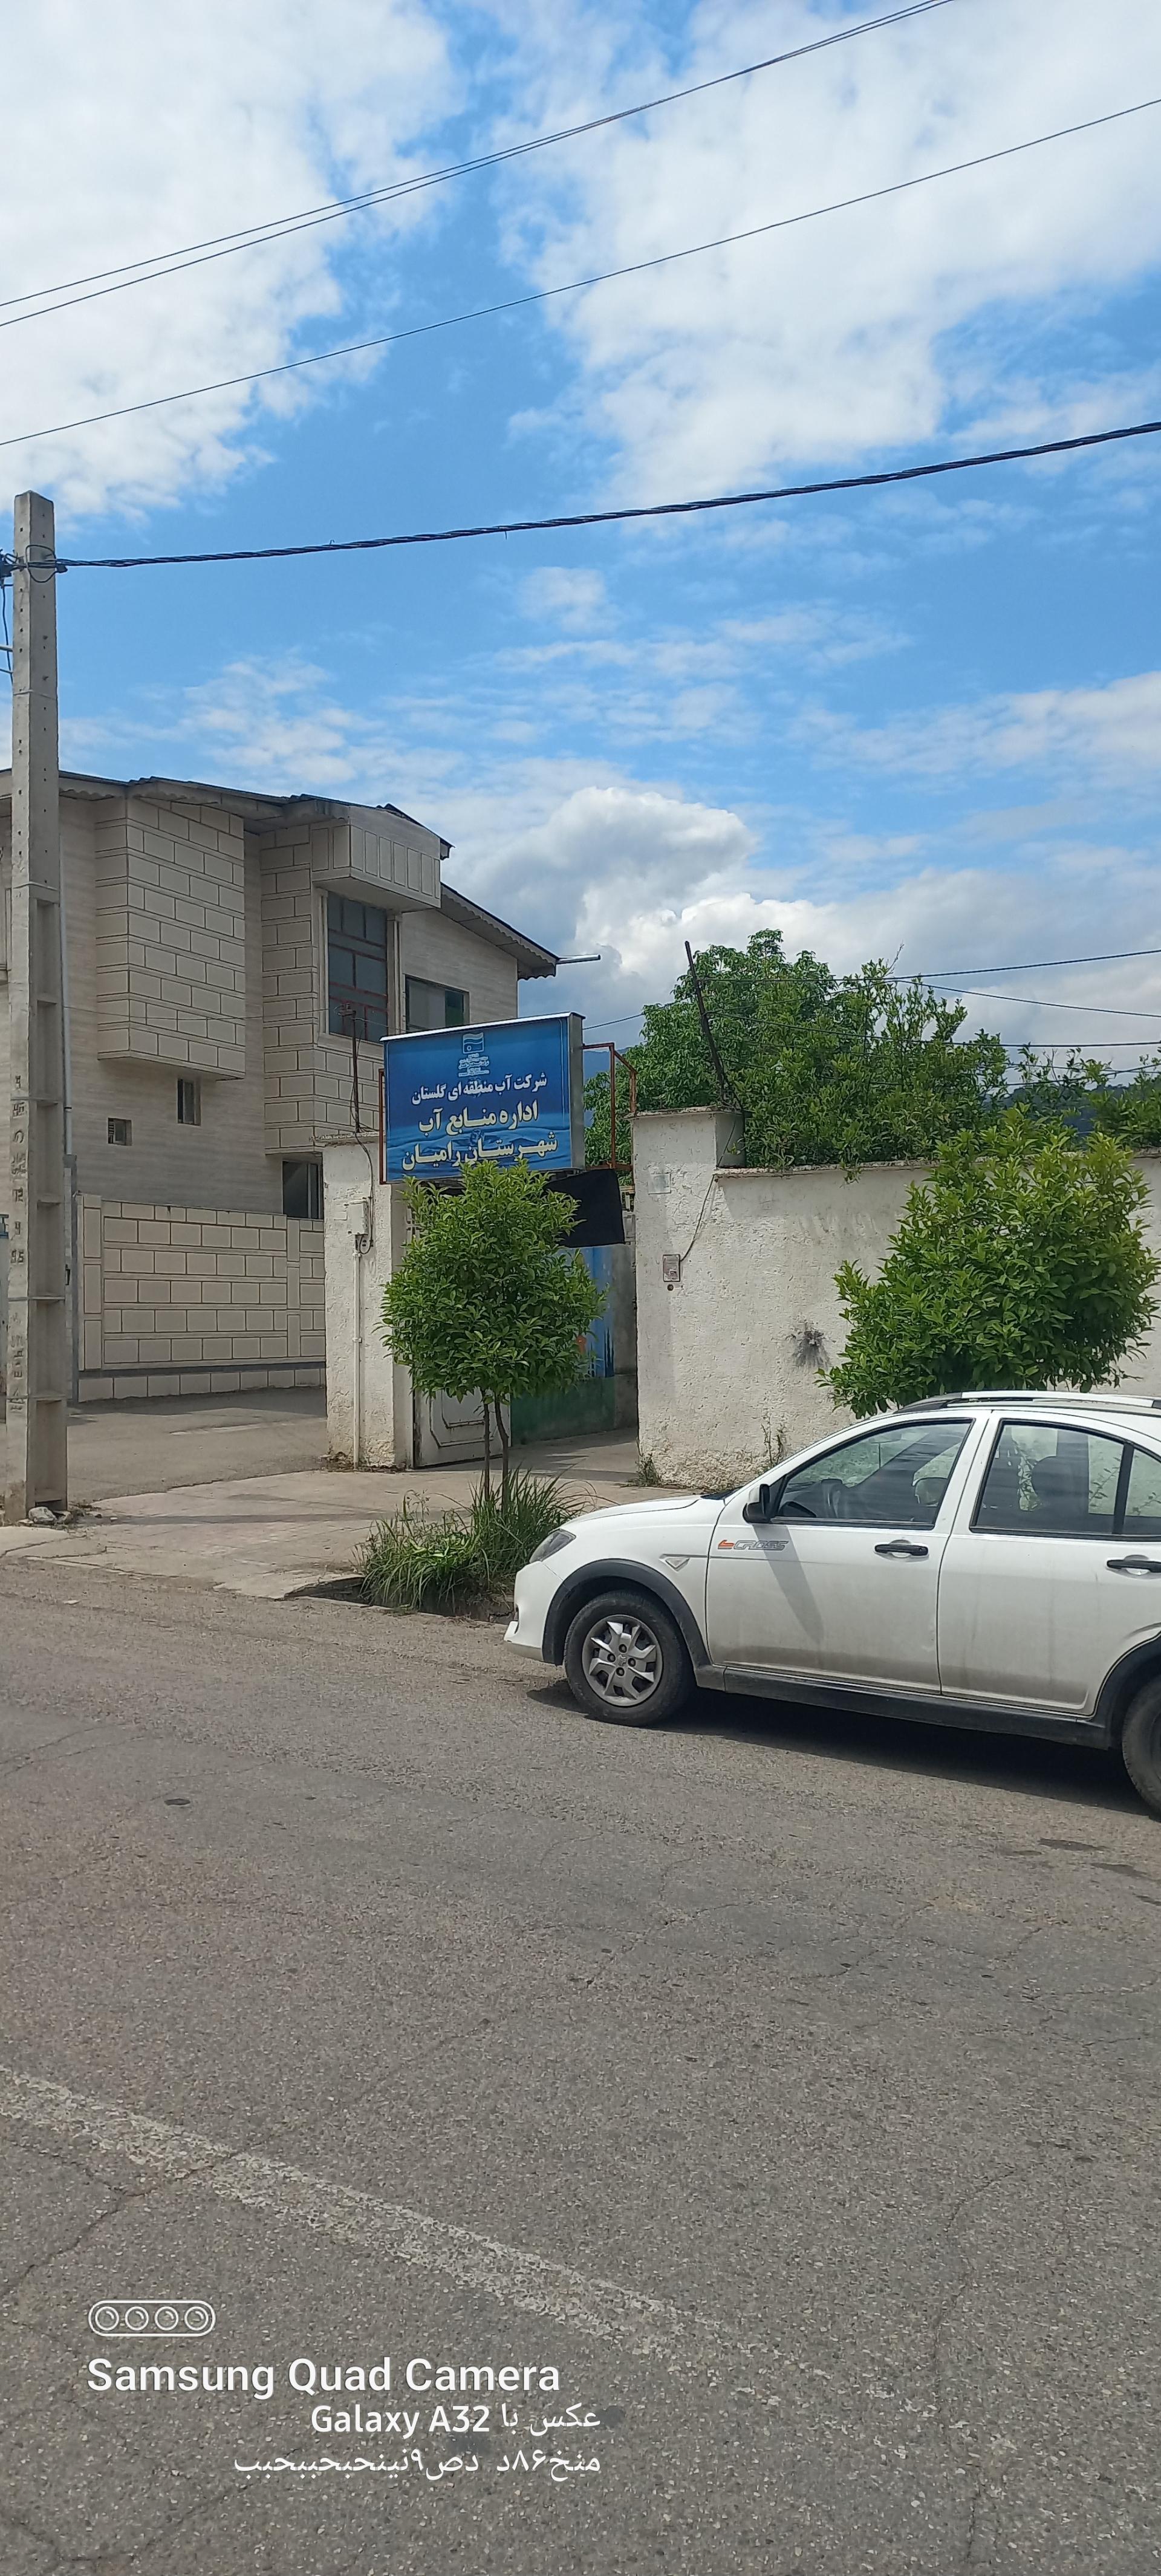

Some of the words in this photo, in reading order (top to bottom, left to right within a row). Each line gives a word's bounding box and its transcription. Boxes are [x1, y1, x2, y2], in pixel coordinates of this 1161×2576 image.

[411, 1083, 447, 1105] گلستان
[448, 1082, 462, 1101] ای
[463, 1080, 493, 1097] منطقه
[495, 1074, 513, 1095] آب
[513, 1072, 547, 1093] شرکت
[418, 1108, 443, 1137] آب
[445, 1107, 496, 1136] منابع
[499, 1099, 538, 1130] اداره
[402, 1141, 461, 1171] رامیان
[464, 1131, 558, 1165] شهرستان
